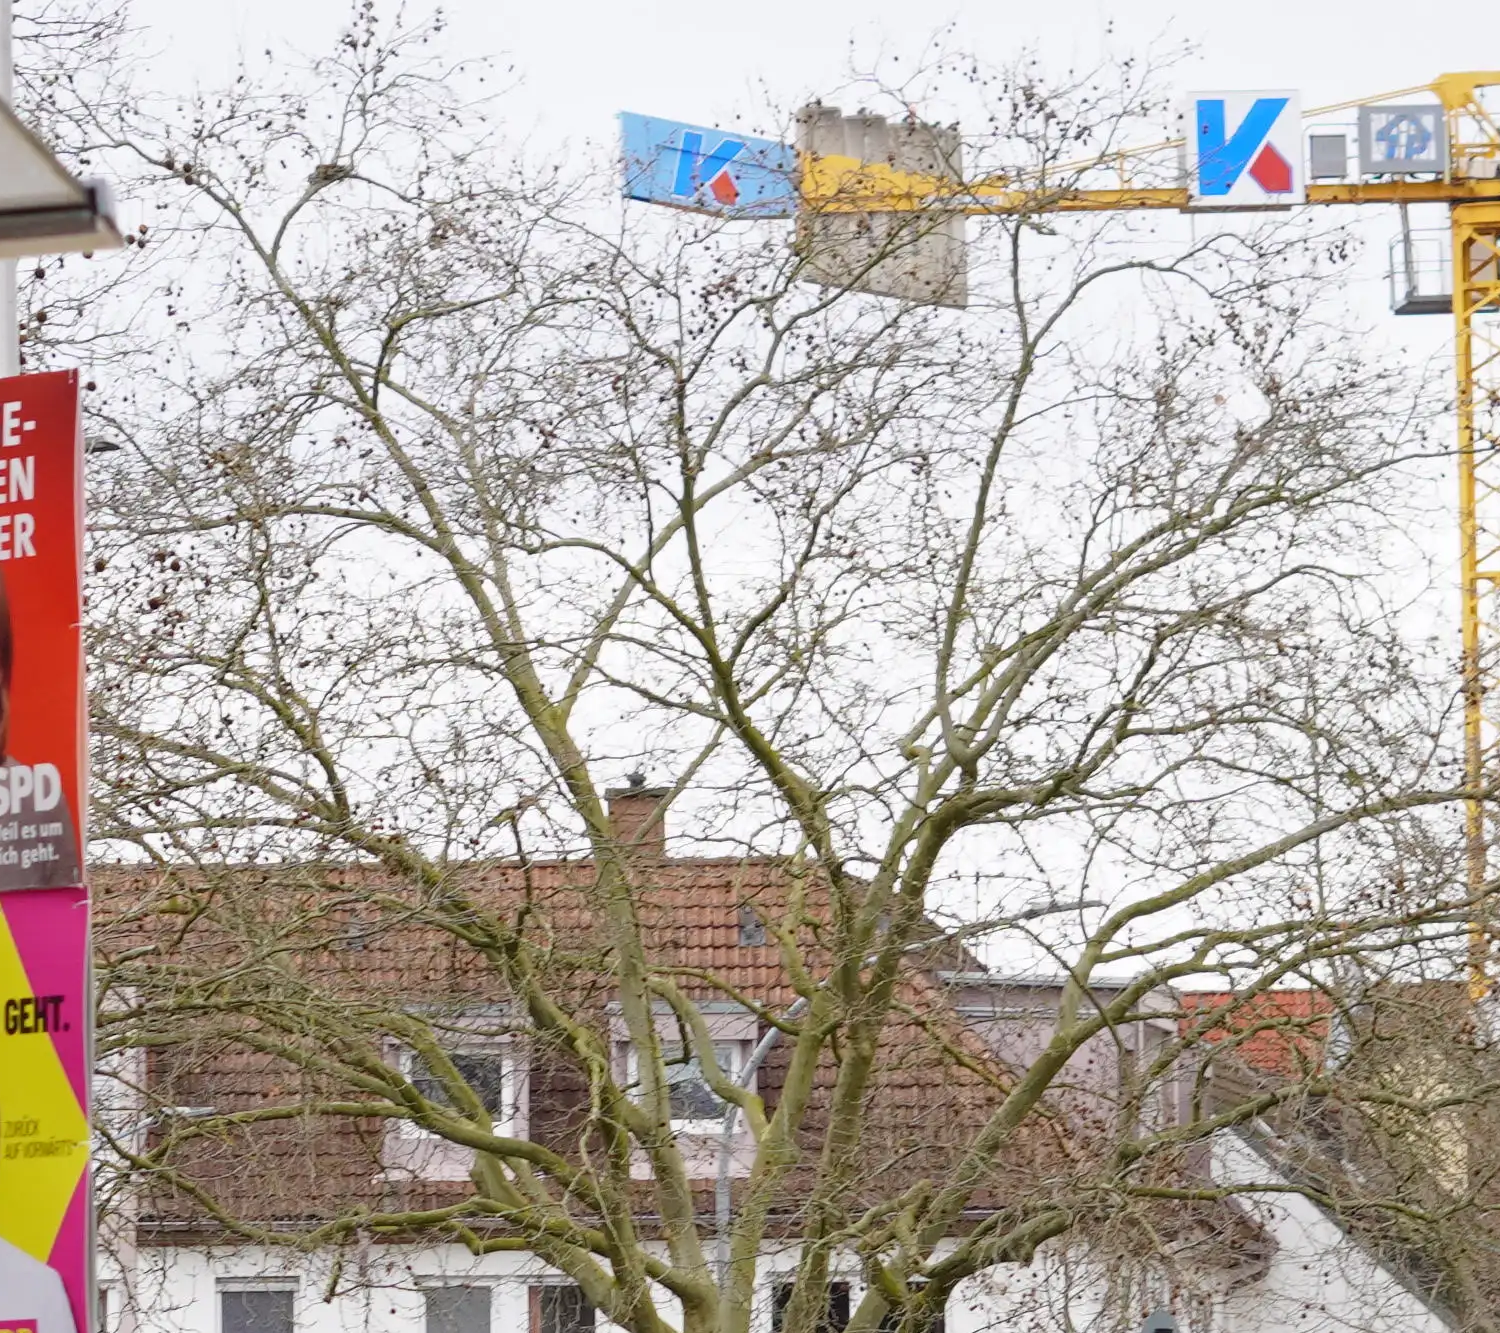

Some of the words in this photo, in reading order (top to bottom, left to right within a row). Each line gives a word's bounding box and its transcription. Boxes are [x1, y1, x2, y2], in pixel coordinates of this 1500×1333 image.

[21, 826, 37, 842] es
[40, 824, 62, 838] um
[21, 844, 60, 869] geht.
[5, 995, 71, 1036] GEHT.
